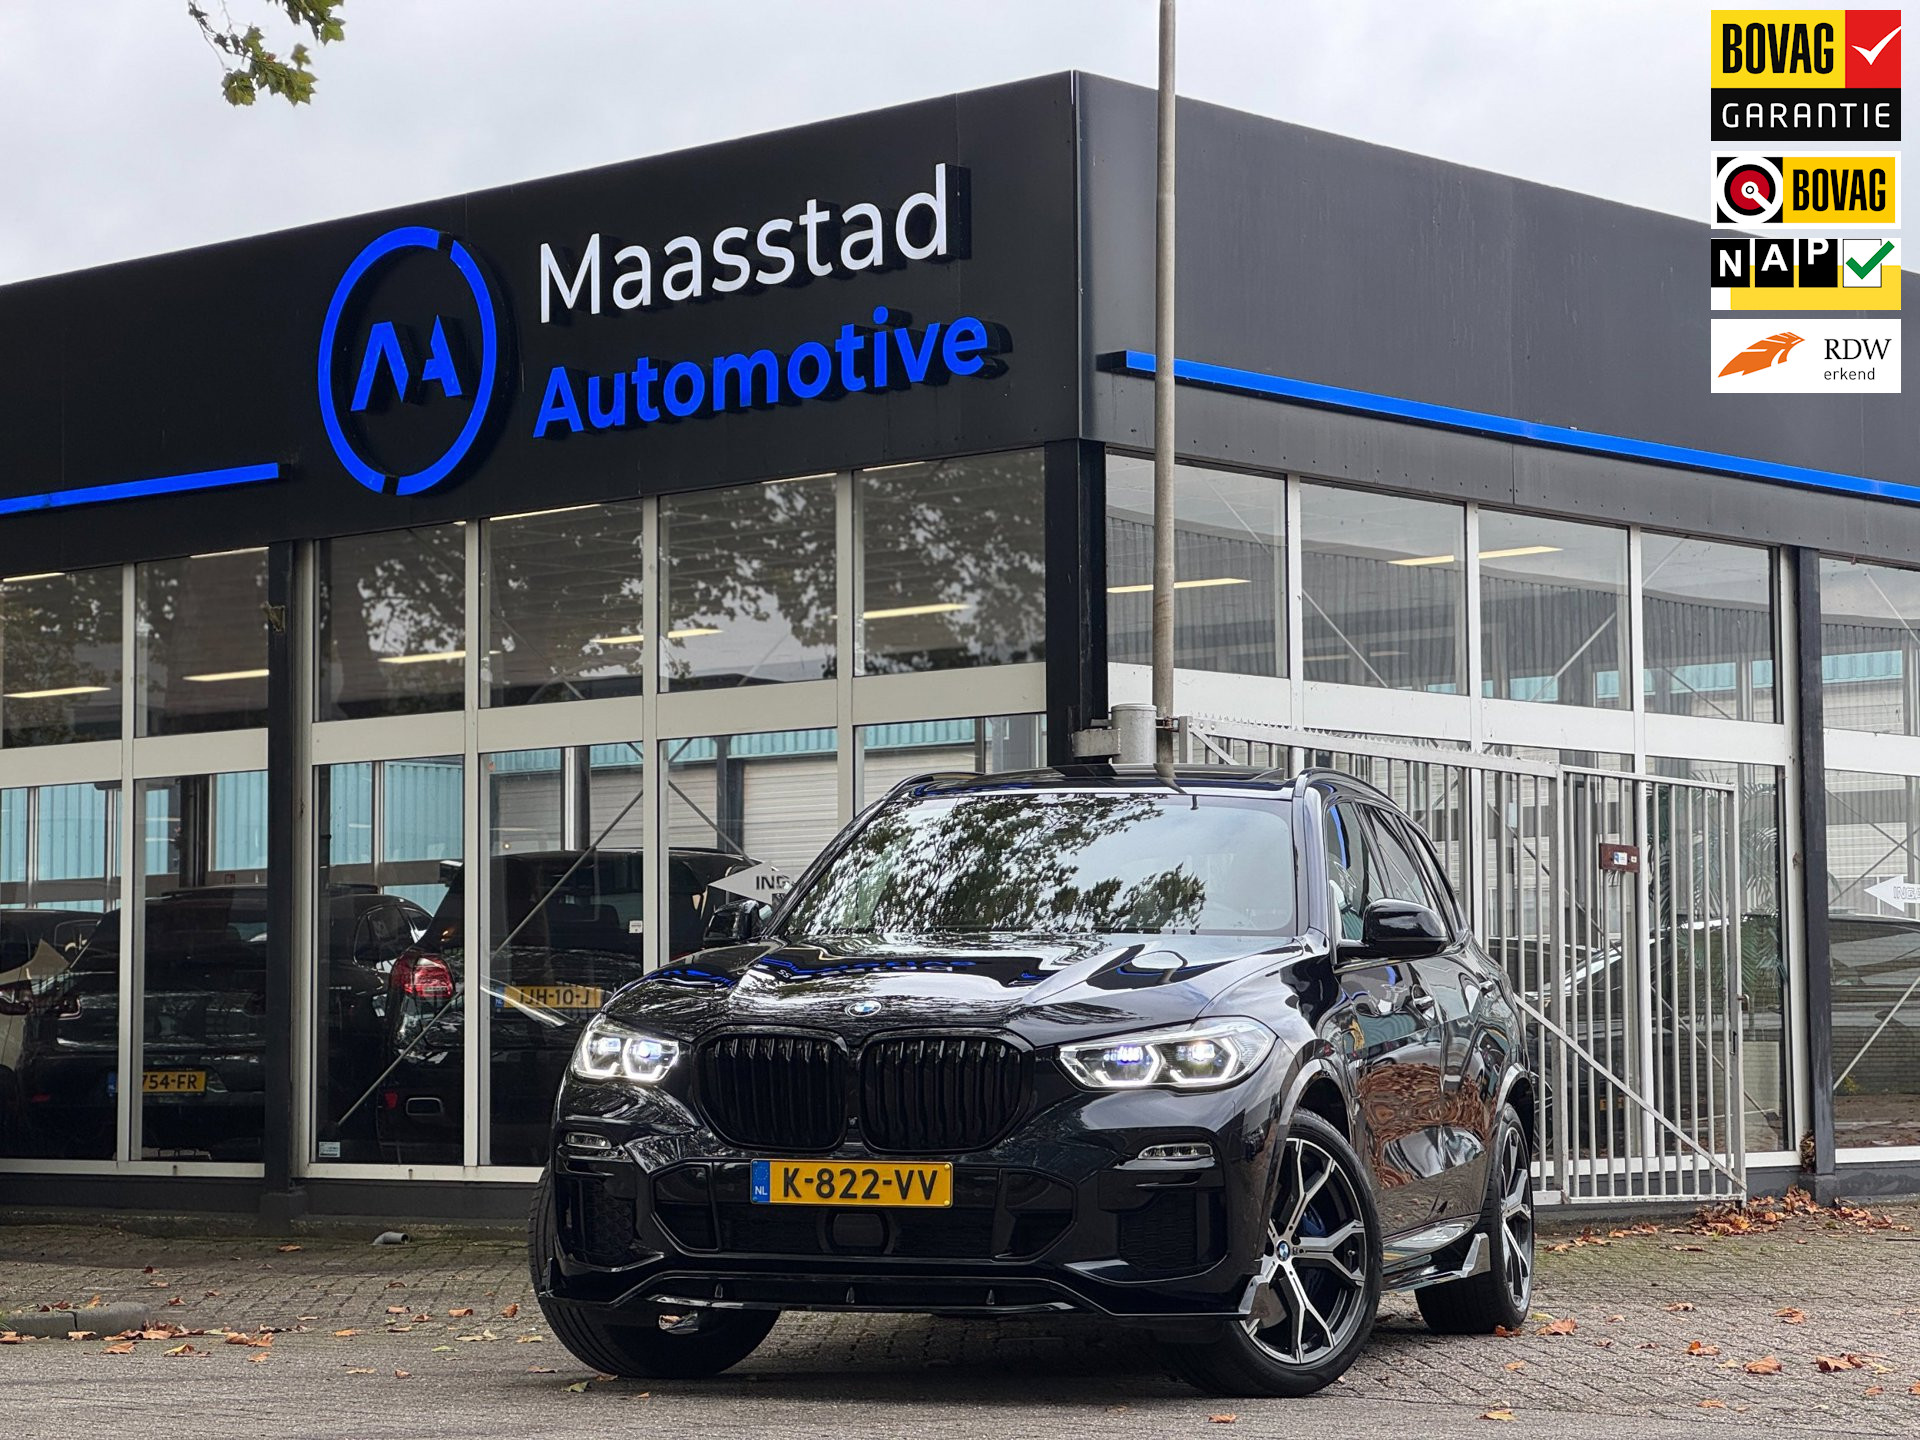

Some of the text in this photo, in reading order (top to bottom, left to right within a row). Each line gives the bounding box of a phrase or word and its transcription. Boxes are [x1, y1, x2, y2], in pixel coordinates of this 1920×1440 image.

[540, 162, 949, 323] Maasstad
[533, 305, 989, 438] Automotive
[754, 1166, 938, 1201] NL K-822-VV
